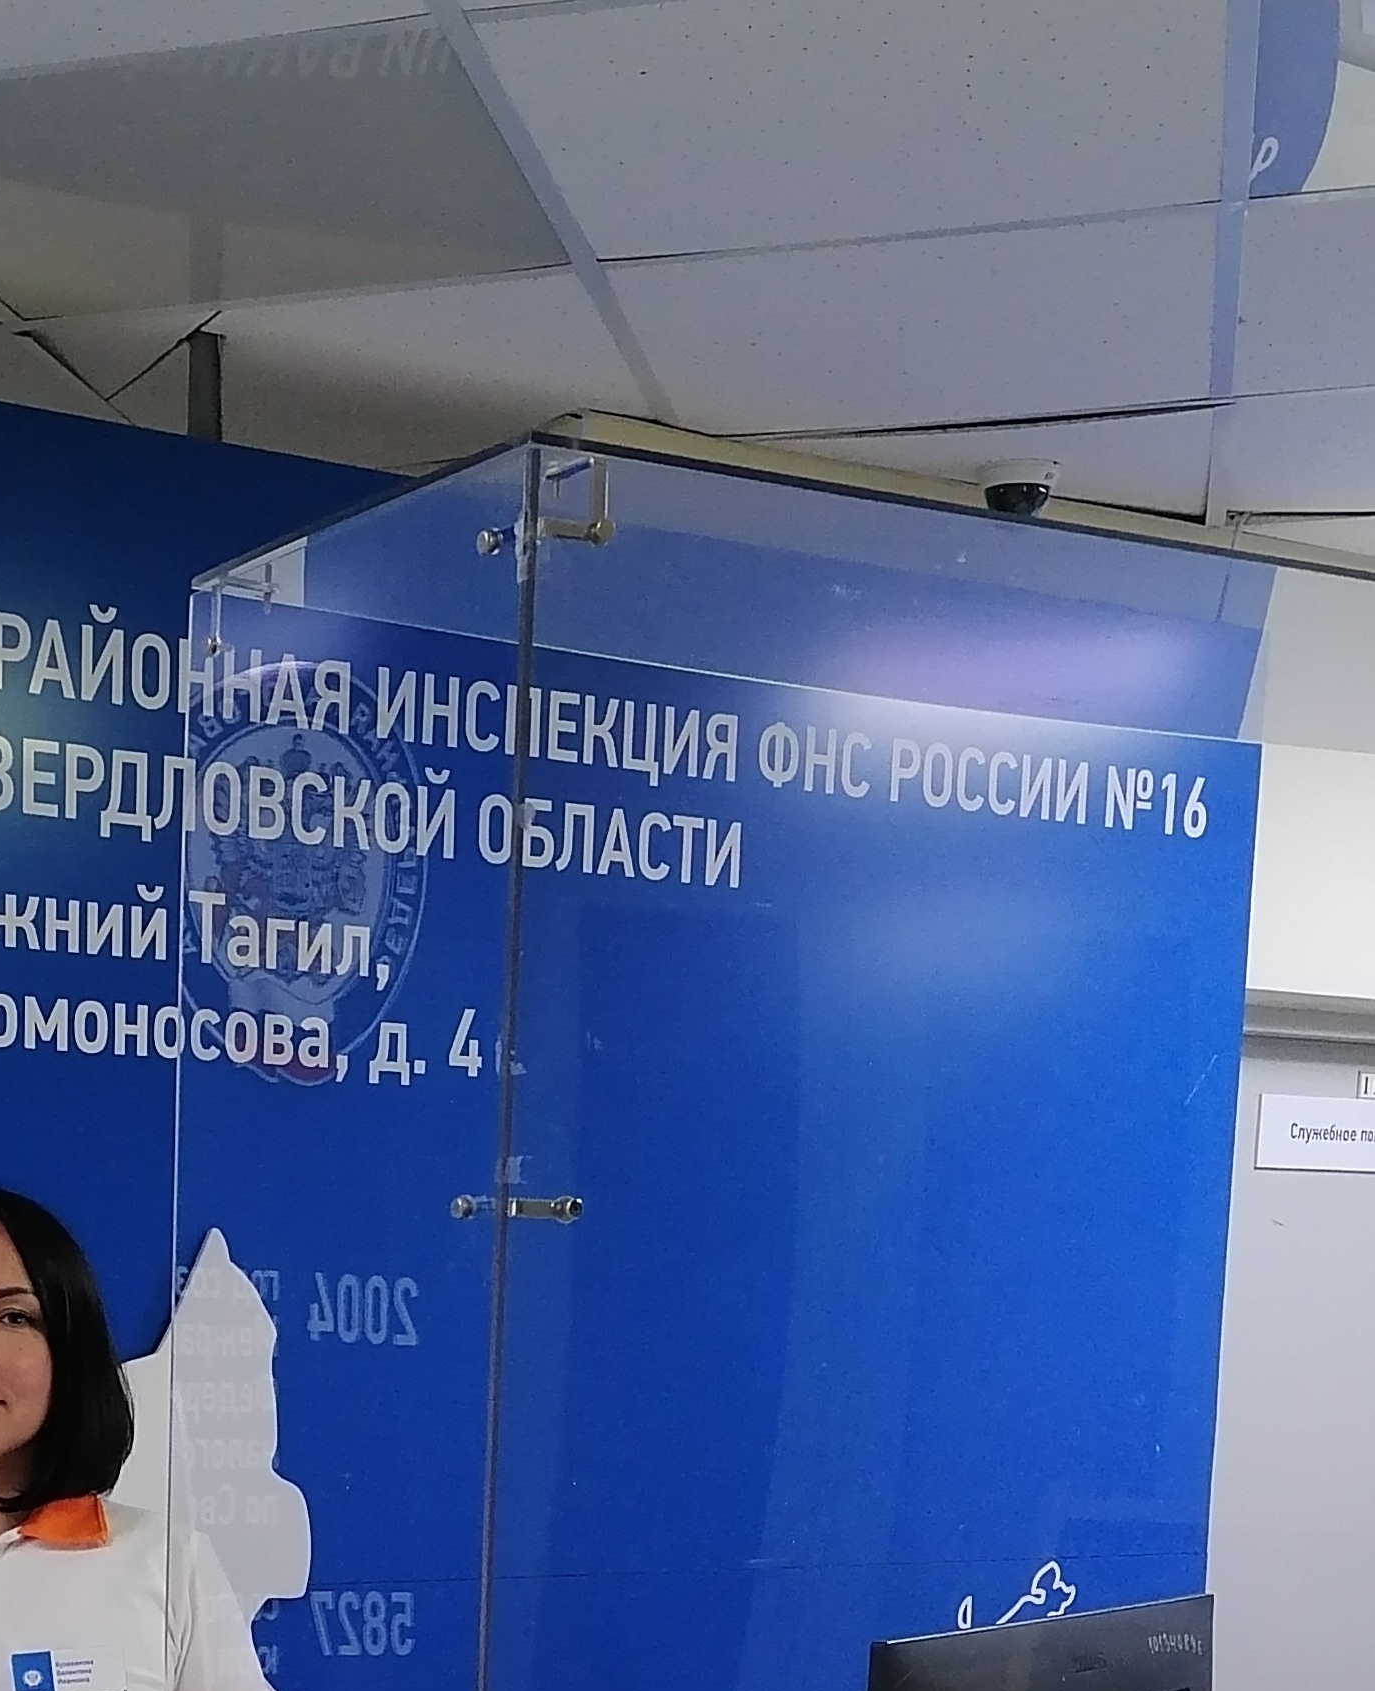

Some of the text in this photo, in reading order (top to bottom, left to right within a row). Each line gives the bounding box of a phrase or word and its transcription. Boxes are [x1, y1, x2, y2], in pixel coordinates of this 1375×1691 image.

[376, 666, 739, 787] ИНСПЕКЦИЯ
[758, 722, 871, 798] ФНС
[889, 737, 1089, 825] РОССИИ
[478, 792, 743, 889] ОБЛАСТИ
[187, 890, 390, 992] Тагил,
[368, 1020, 427, 1085] д.
[1290, 1122, 1375, 1145] Служебное по
